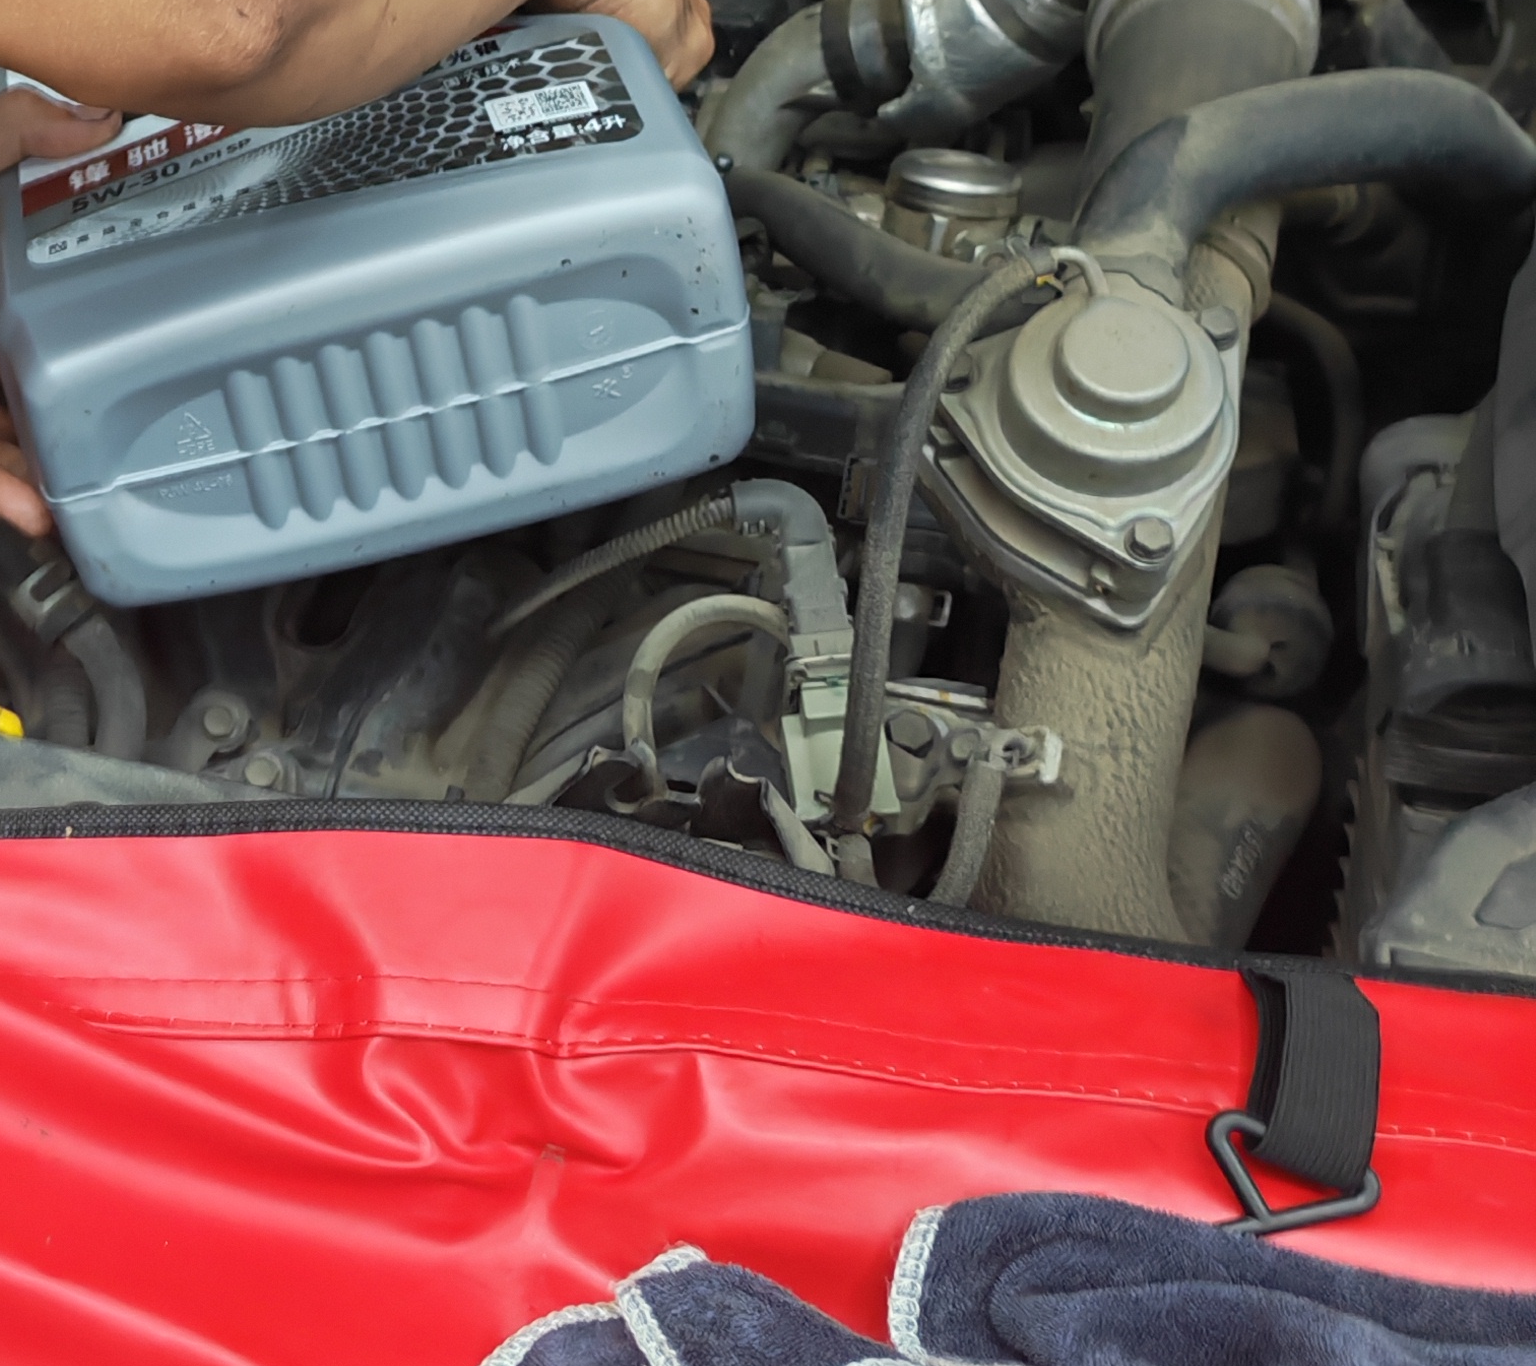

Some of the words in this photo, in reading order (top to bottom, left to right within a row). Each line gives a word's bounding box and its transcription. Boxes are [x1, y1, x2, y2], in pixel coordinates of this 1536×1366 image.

[71, 161, 181, 215] 5W-30
[189, 146, 222, 170] API
[225, 137, 251, 156] SP
